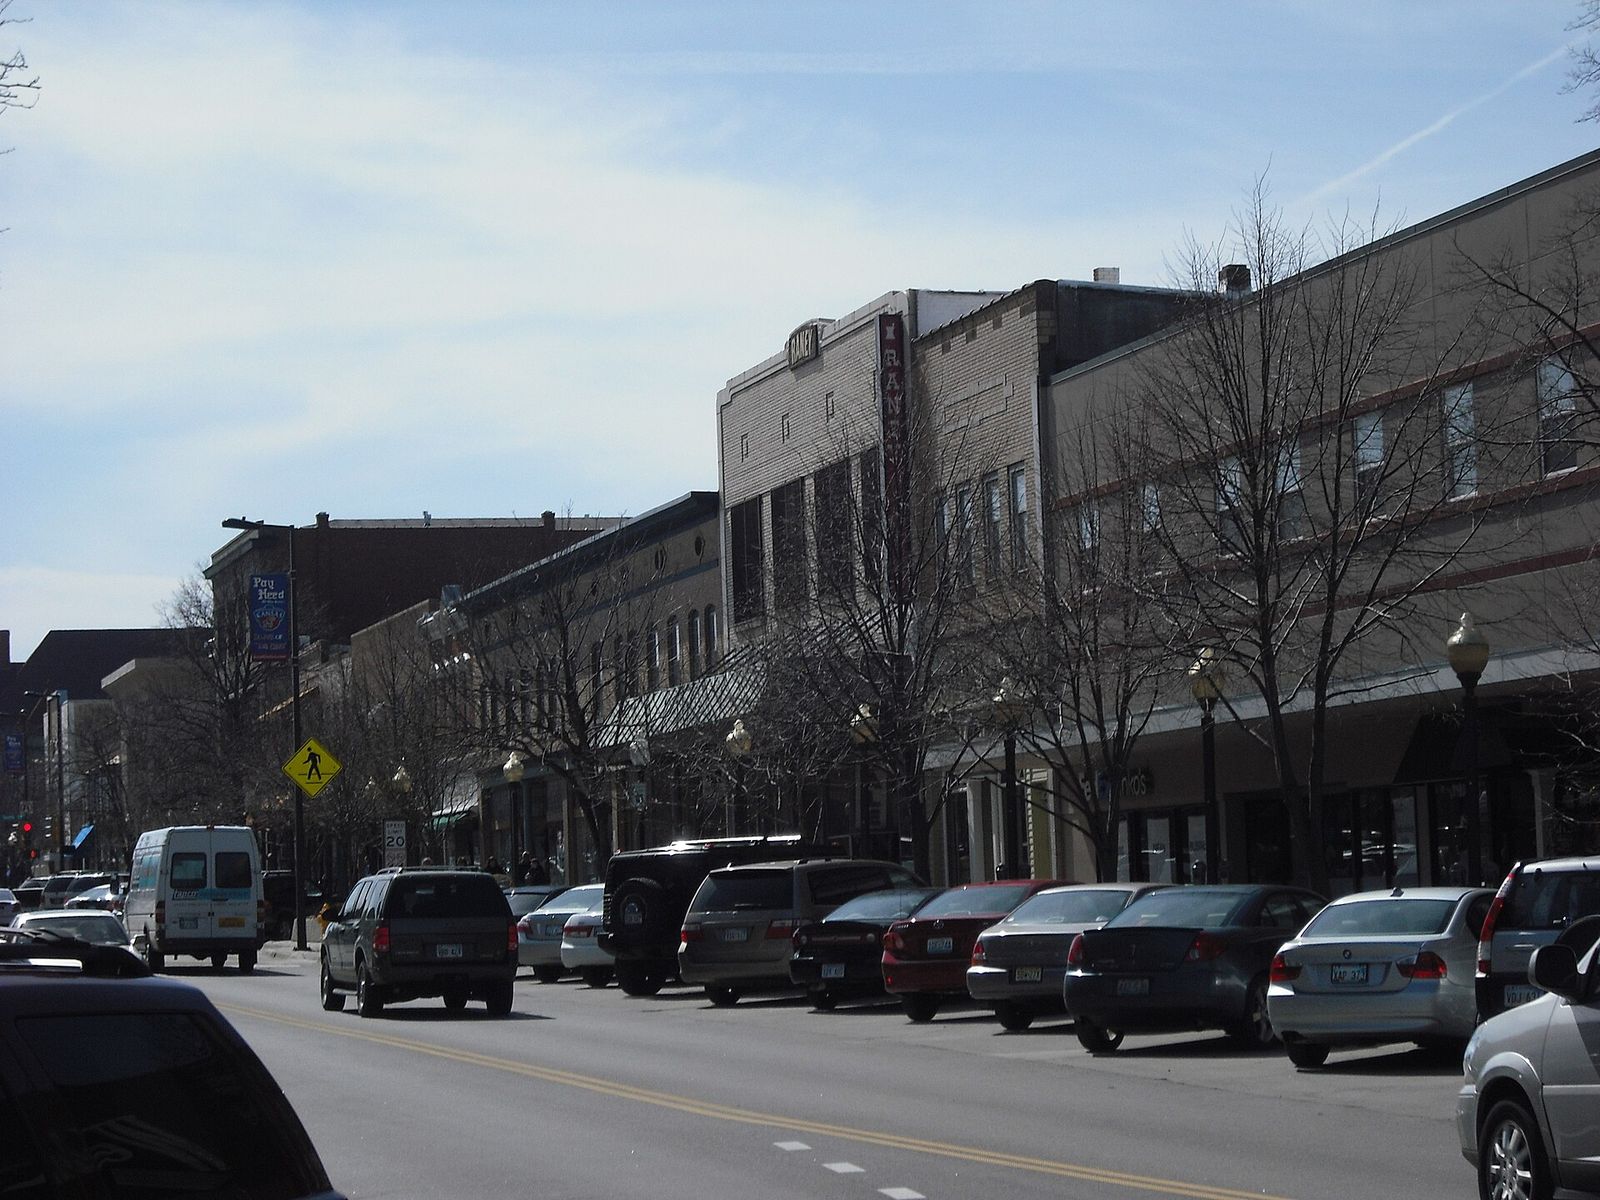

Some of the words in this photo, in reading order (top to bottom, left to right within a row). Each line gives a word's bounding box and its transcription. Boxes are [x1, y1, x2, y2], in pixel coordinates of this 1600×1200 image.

[252, 576, 274, 590] Pay
[258, 588, 285, 600] Heed
[386, 836, 405, 847] 20
